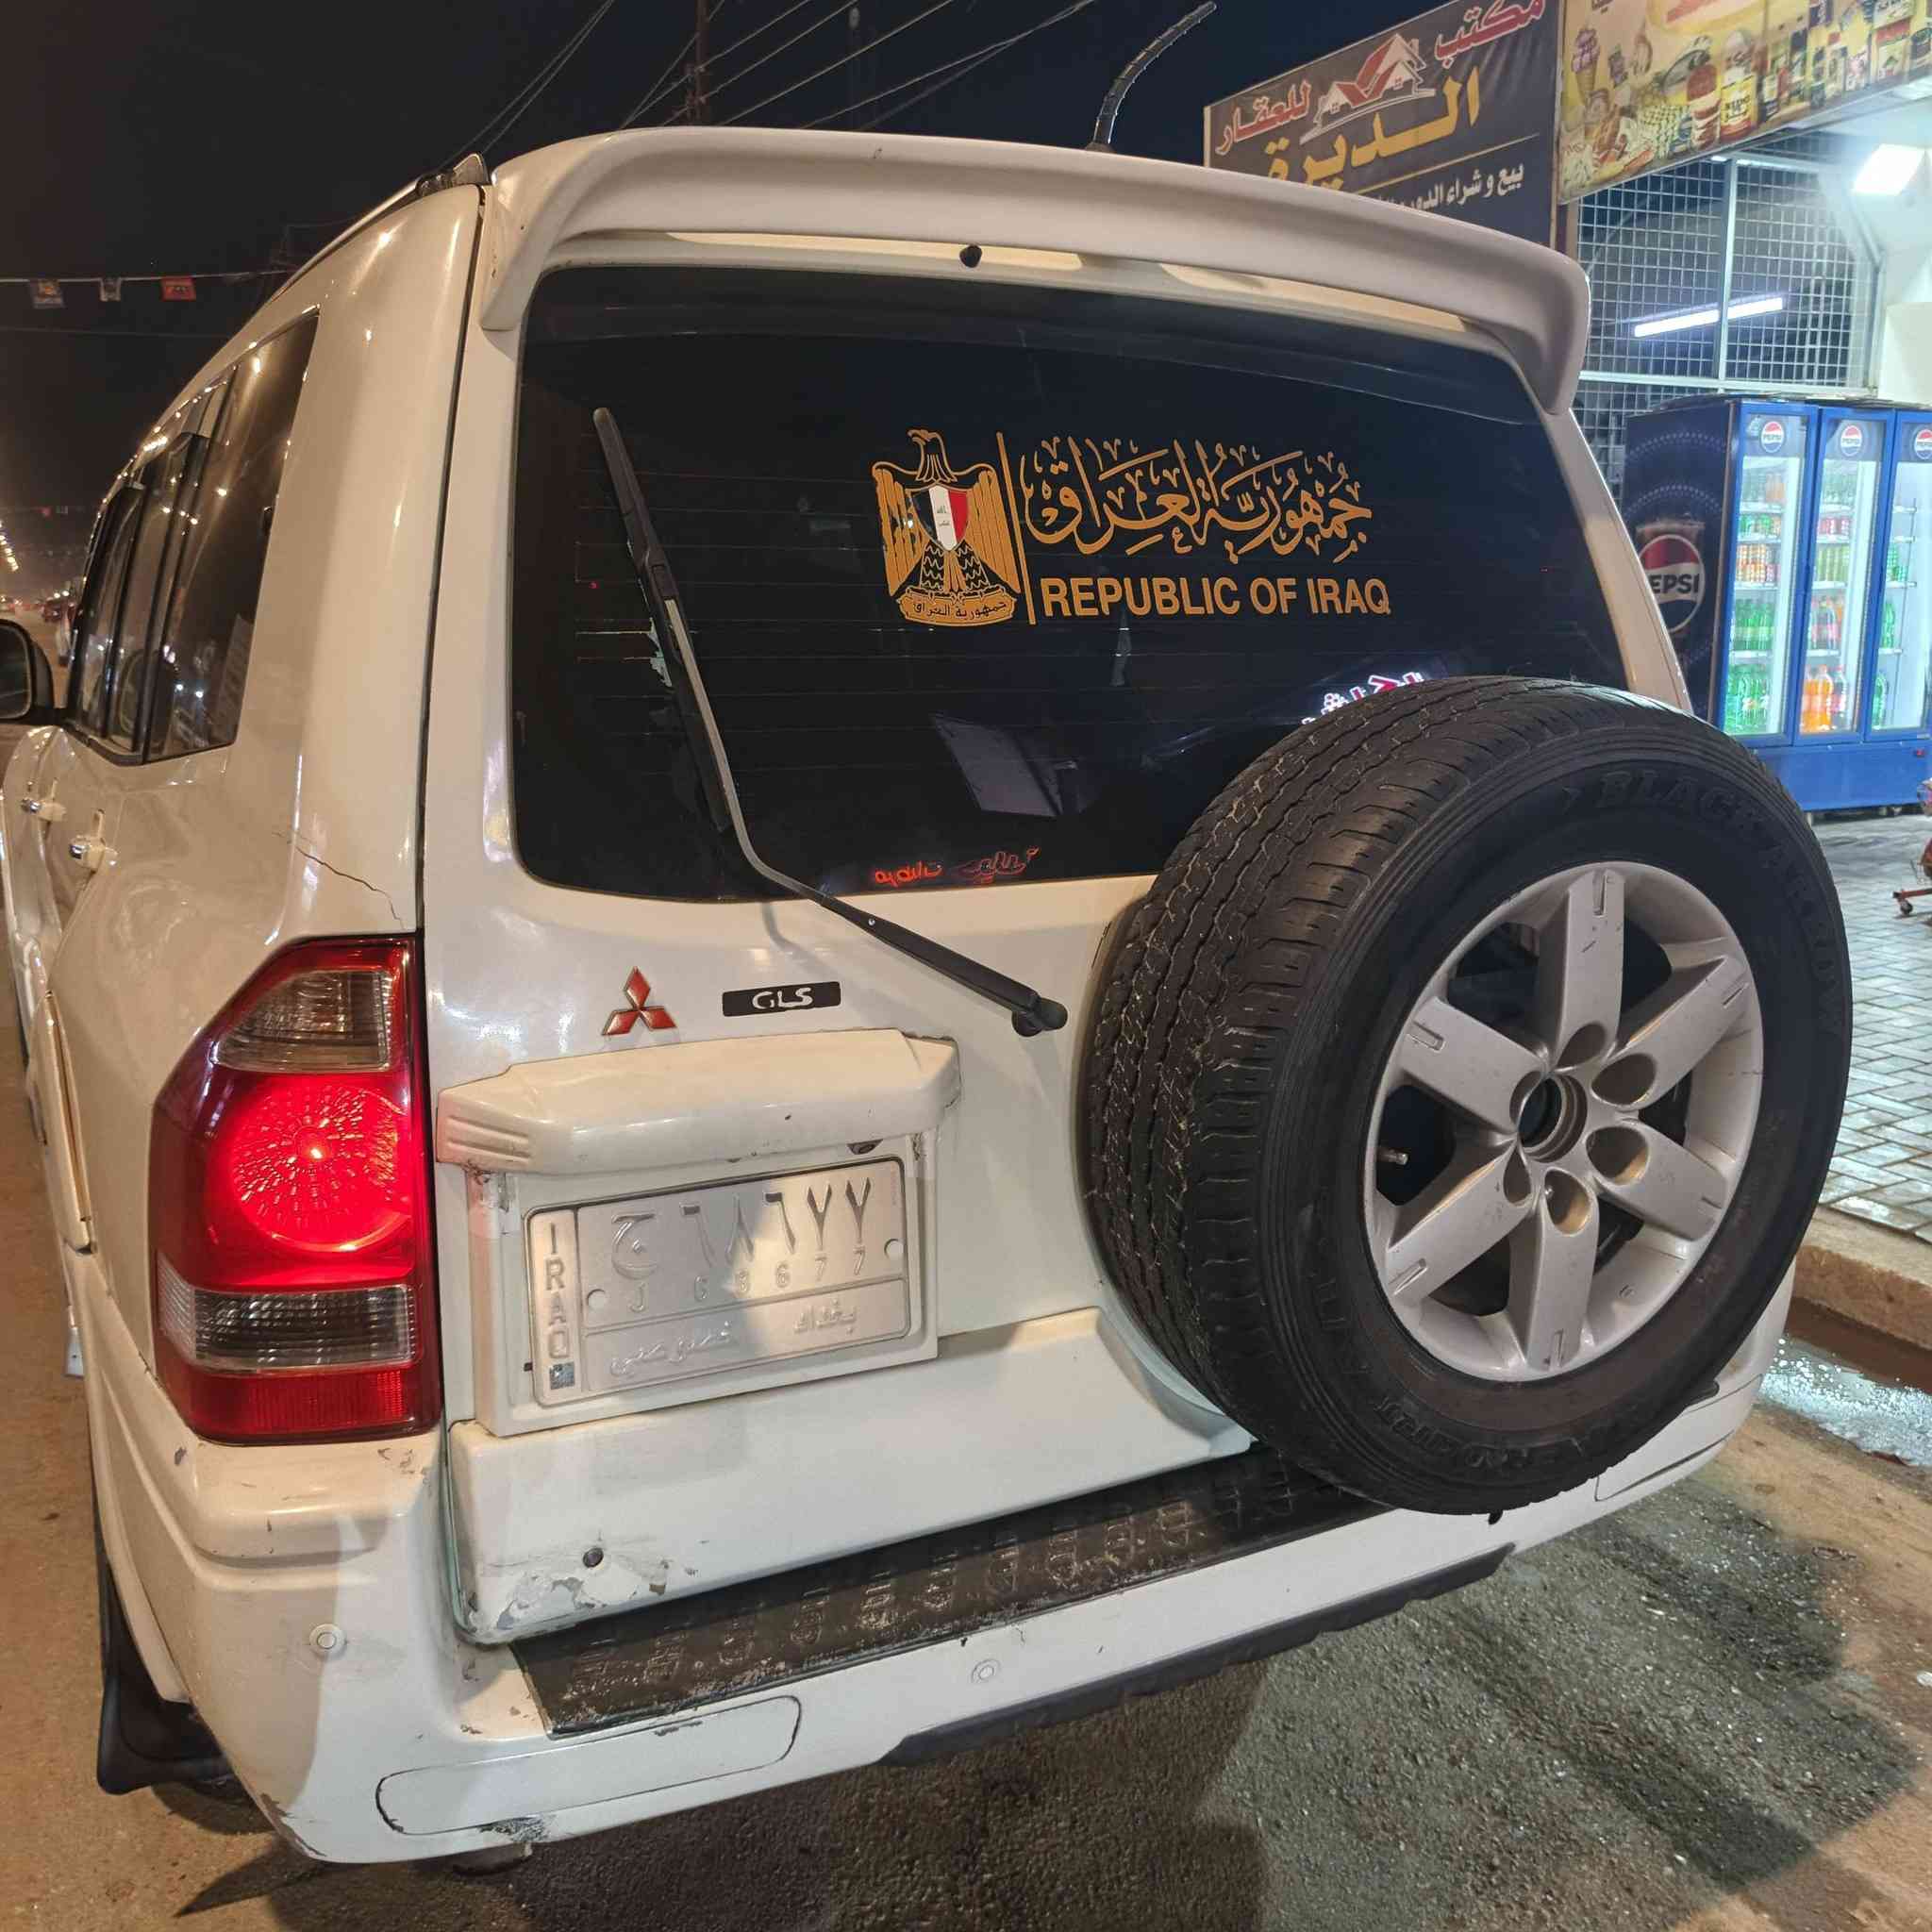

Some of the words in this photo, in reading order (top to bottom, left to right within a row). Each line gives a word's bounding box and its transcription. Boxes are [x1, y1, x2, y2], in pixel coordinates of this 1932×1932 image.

[1435, 0, 1546, 69] مكتب
[1215, 79, 1312, 155] للعقار
[1265, 66, 1480, 190] الديرة
[1446, 169, 1482, 205] شراء
[1482, 174, 1494, 197] و
[1497, 163, 1524, 195] بيع
[1041, 576, 1241, 616] REPUBLIC
[1250, 576, 1298, 615] OF
[1307, 577, 1391, 616] IRAQ
[1648, 573, 1700, 595] EPSI
[956, 601, 1007, 620] جمهورية
[752, 987, 813, 1009] GLS
[611, 1212, 659, 1280] ج
[543, 1223, 571, 1359] IRAQ
